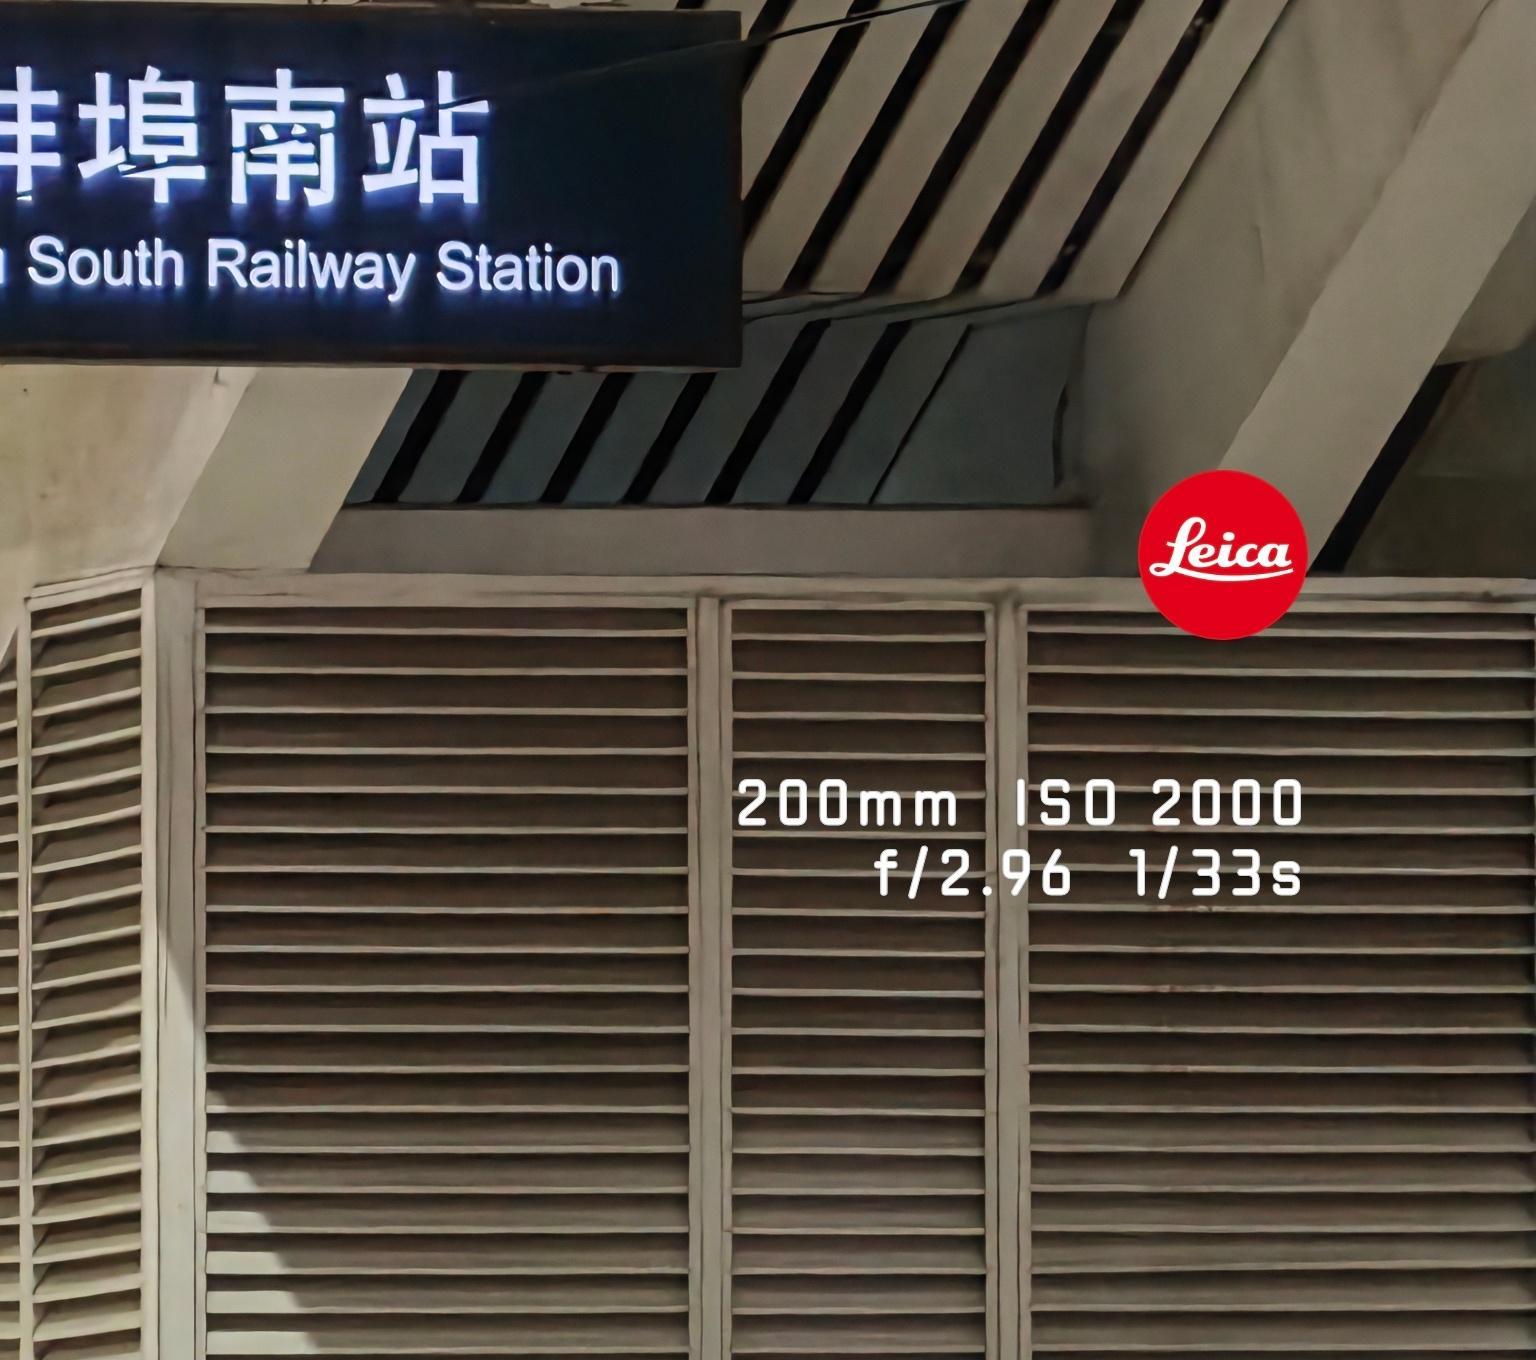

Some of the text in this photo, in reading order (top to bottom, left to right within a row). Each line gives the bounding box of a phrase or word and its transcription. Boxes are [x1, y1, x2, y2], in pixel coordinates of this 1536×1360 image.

[27, 235, 184, 289] South
[208, 237, 417, 303] Railway
[436, 240, 619, 293] Station
